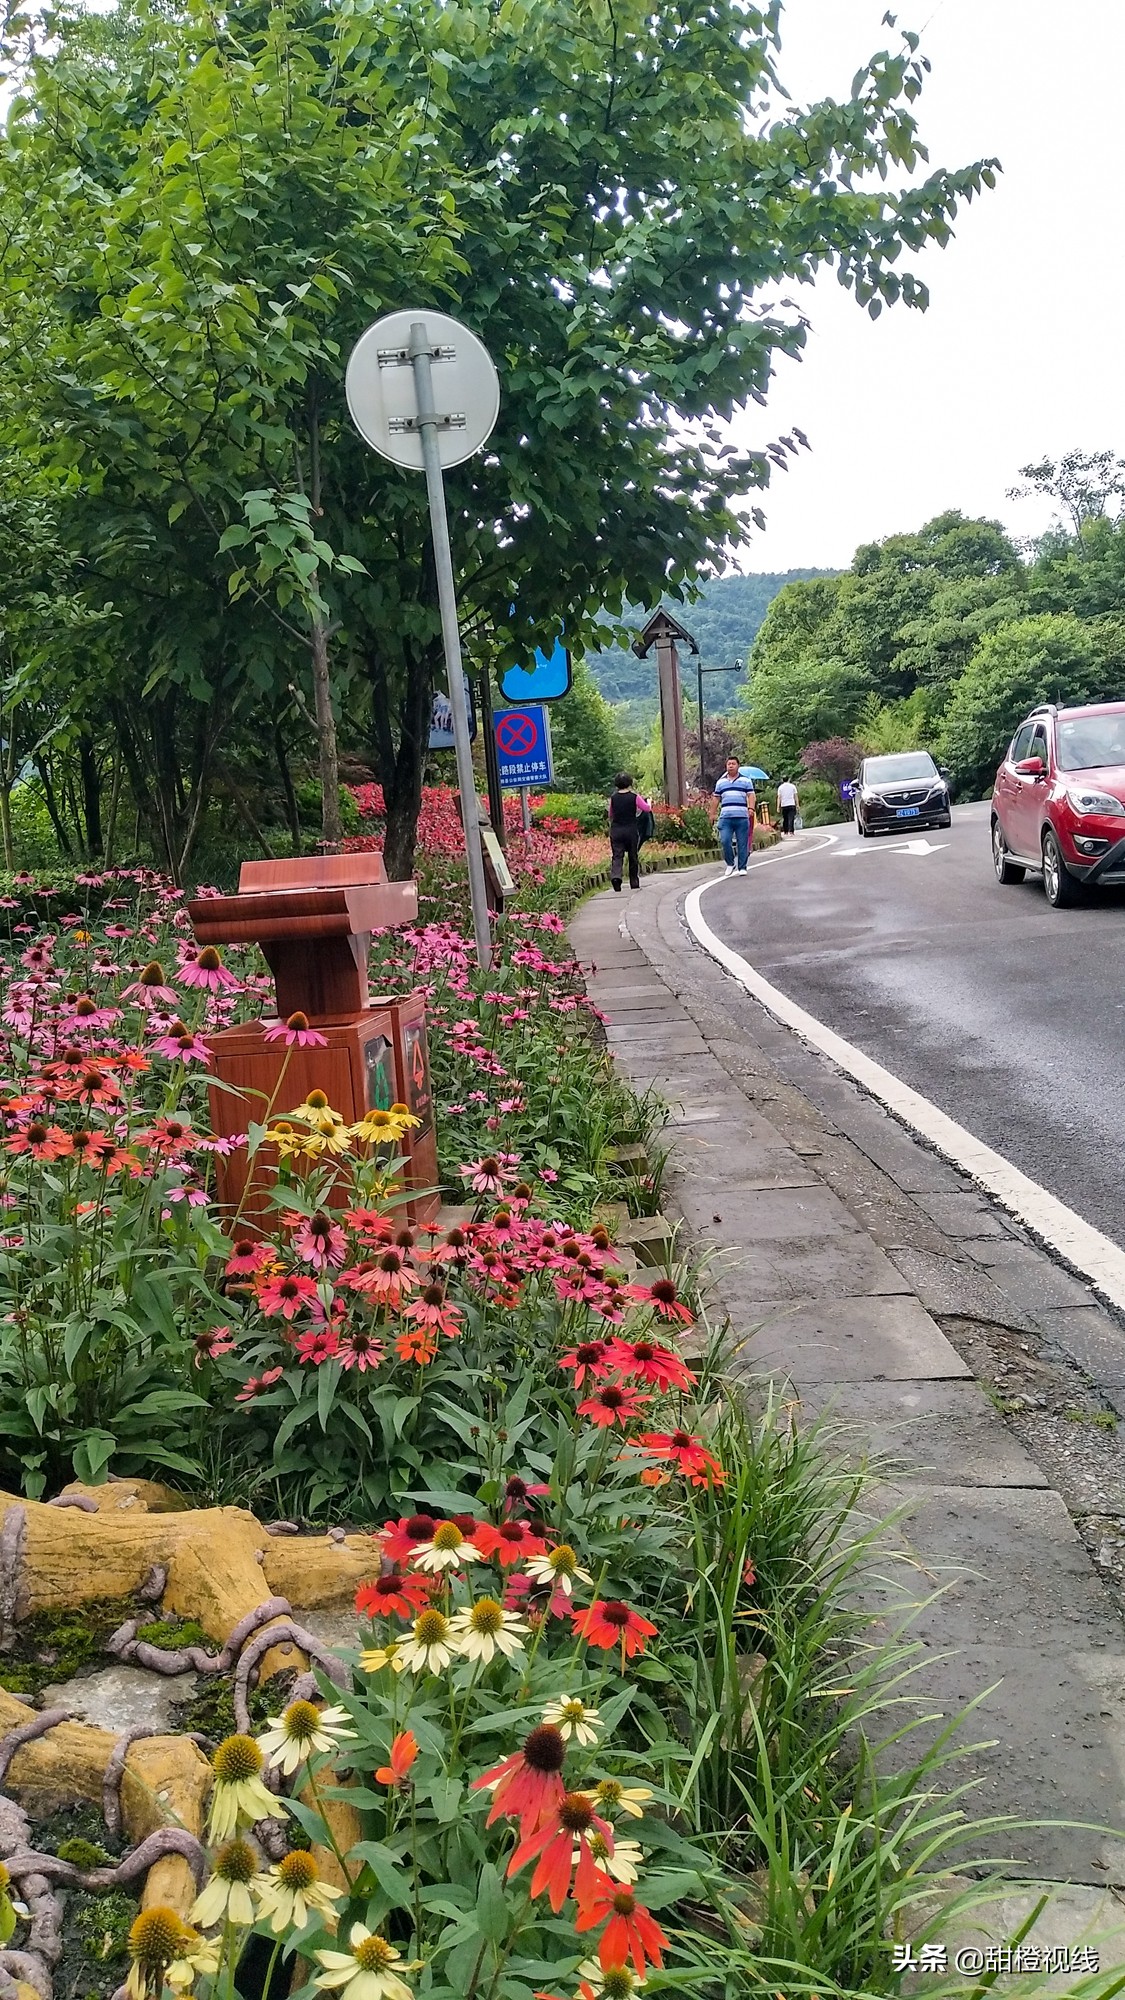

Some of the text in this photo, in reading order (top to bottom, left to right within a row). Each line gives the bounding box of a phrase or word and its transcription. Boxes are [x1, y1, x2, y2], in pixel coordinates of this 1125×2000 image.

[500, 761, 546, 775] 路段禁止停车
